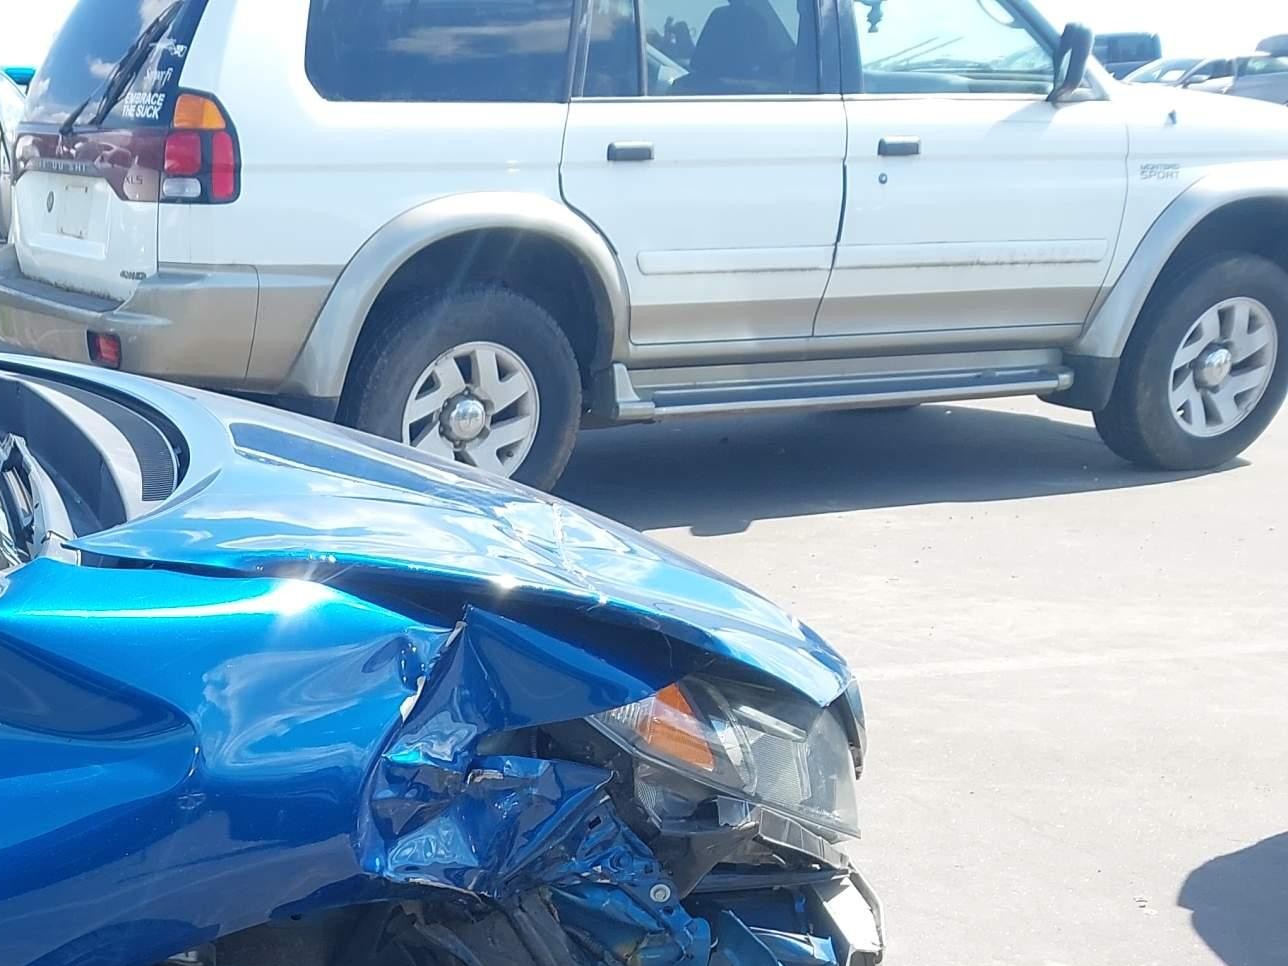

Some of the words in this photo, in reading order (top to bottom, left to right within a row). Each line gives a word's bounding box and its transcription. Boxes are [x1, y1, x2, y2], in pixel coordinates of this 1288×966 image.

[124, 91, 166, 106] EMBRACE
[122, 104, 137, 118] THE
[135, 105, 161, 120] SUCK
[125, 175, 143, 185] XLS
[1140, 170, 1180, 180] SPORT
